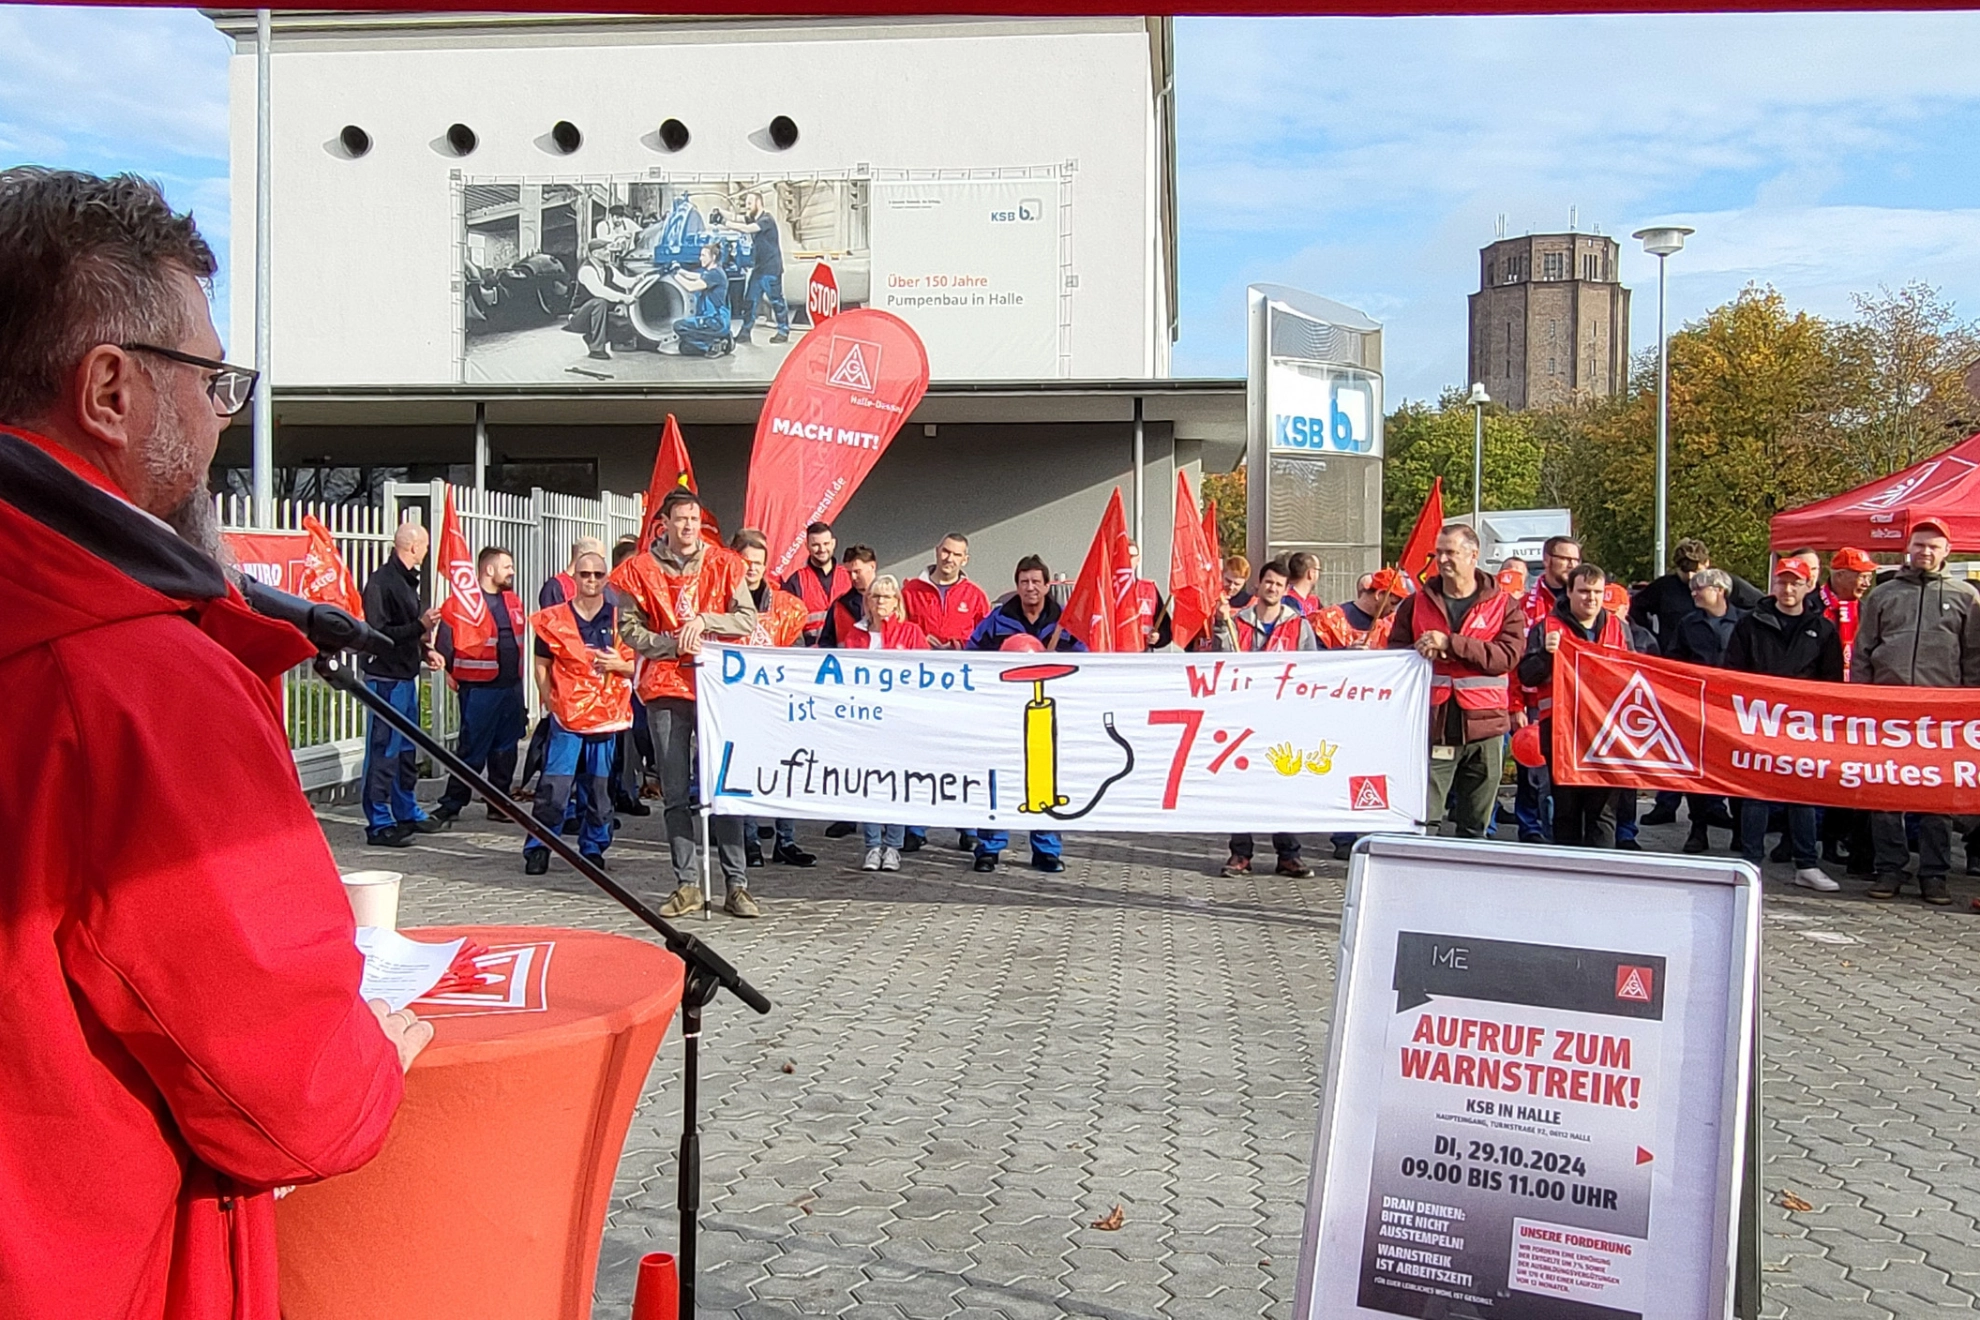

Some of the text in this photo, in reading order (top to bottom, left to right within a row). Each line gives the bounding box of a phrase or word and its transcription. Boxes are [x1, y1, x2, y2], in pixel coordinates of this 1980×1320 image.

[991, 212, 1015, 222] KSB
[888, 274, 988, 288] Über 150 Jahre
[810, 280, 837, 318] STOP
[887, 293, 1023, 308] Pumpenbau in Halle
[772, 418, 880, 450] MACH MIT!
[1276, 414, 1324, 449] KSB
[815, 653, 976, 692] Angebot
[1186, 660, 1393, 701] Wir fordern
[788, 694, 883, 722] ist eine
[714, 741, 997, 821] Luftnummer!
[1732, 749, 1980, 789] unser gutes R
[1412, 1013, 1631, 1070] AUFRUF ZUM
[1400, 1047, 1641, 1110] WARNSTREIK!
[1466, 1099, 1561, 1125] KSB IN HALLE
[1570, 1133, 1591, 1142] HALLE
[1434, 1135, 1586, 1177] DI, 29.10.2024
[1401, 1157, 1618, 1210] 09.00 BIS 11.00 UHR
[1381, 1210, 1450, 1232] BITTE NICHT
[1383, 1196, 1466, 1221] DRAN DENKEN:
[1379, 1224, 1464, 1250] AUSSTEMPELN!
[1520, 1226, 1632, 1256] UNSERE FORDERUNG
[1378, 1243, 1452, 1268] WARNSTREIK
[1376, 1257, 1473, 1287] IST ARBEITSZEIT!
